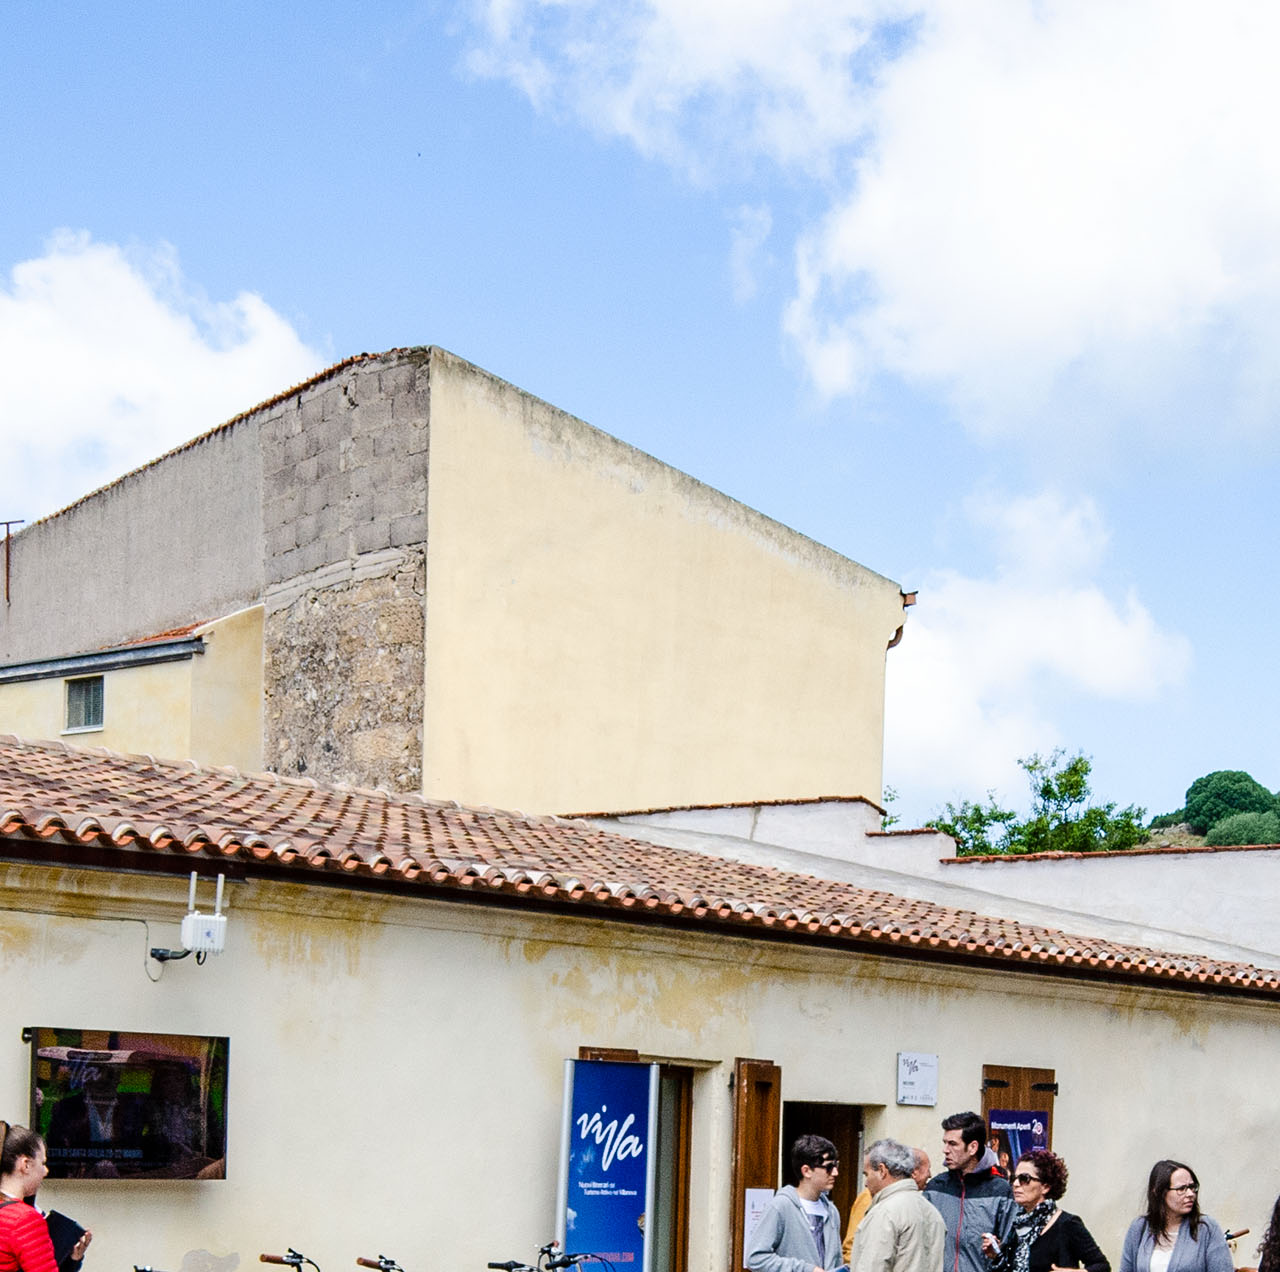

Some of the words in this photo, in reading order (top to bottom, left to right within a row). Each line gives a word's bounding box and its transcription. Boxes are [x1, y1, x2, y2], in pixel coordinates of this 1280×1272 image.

[990, 1121, 1016, 1130] Monumenti
[1017, 1122, 1031, 1131] Aperti
[1032, 1118, 1044, 1135] 20
